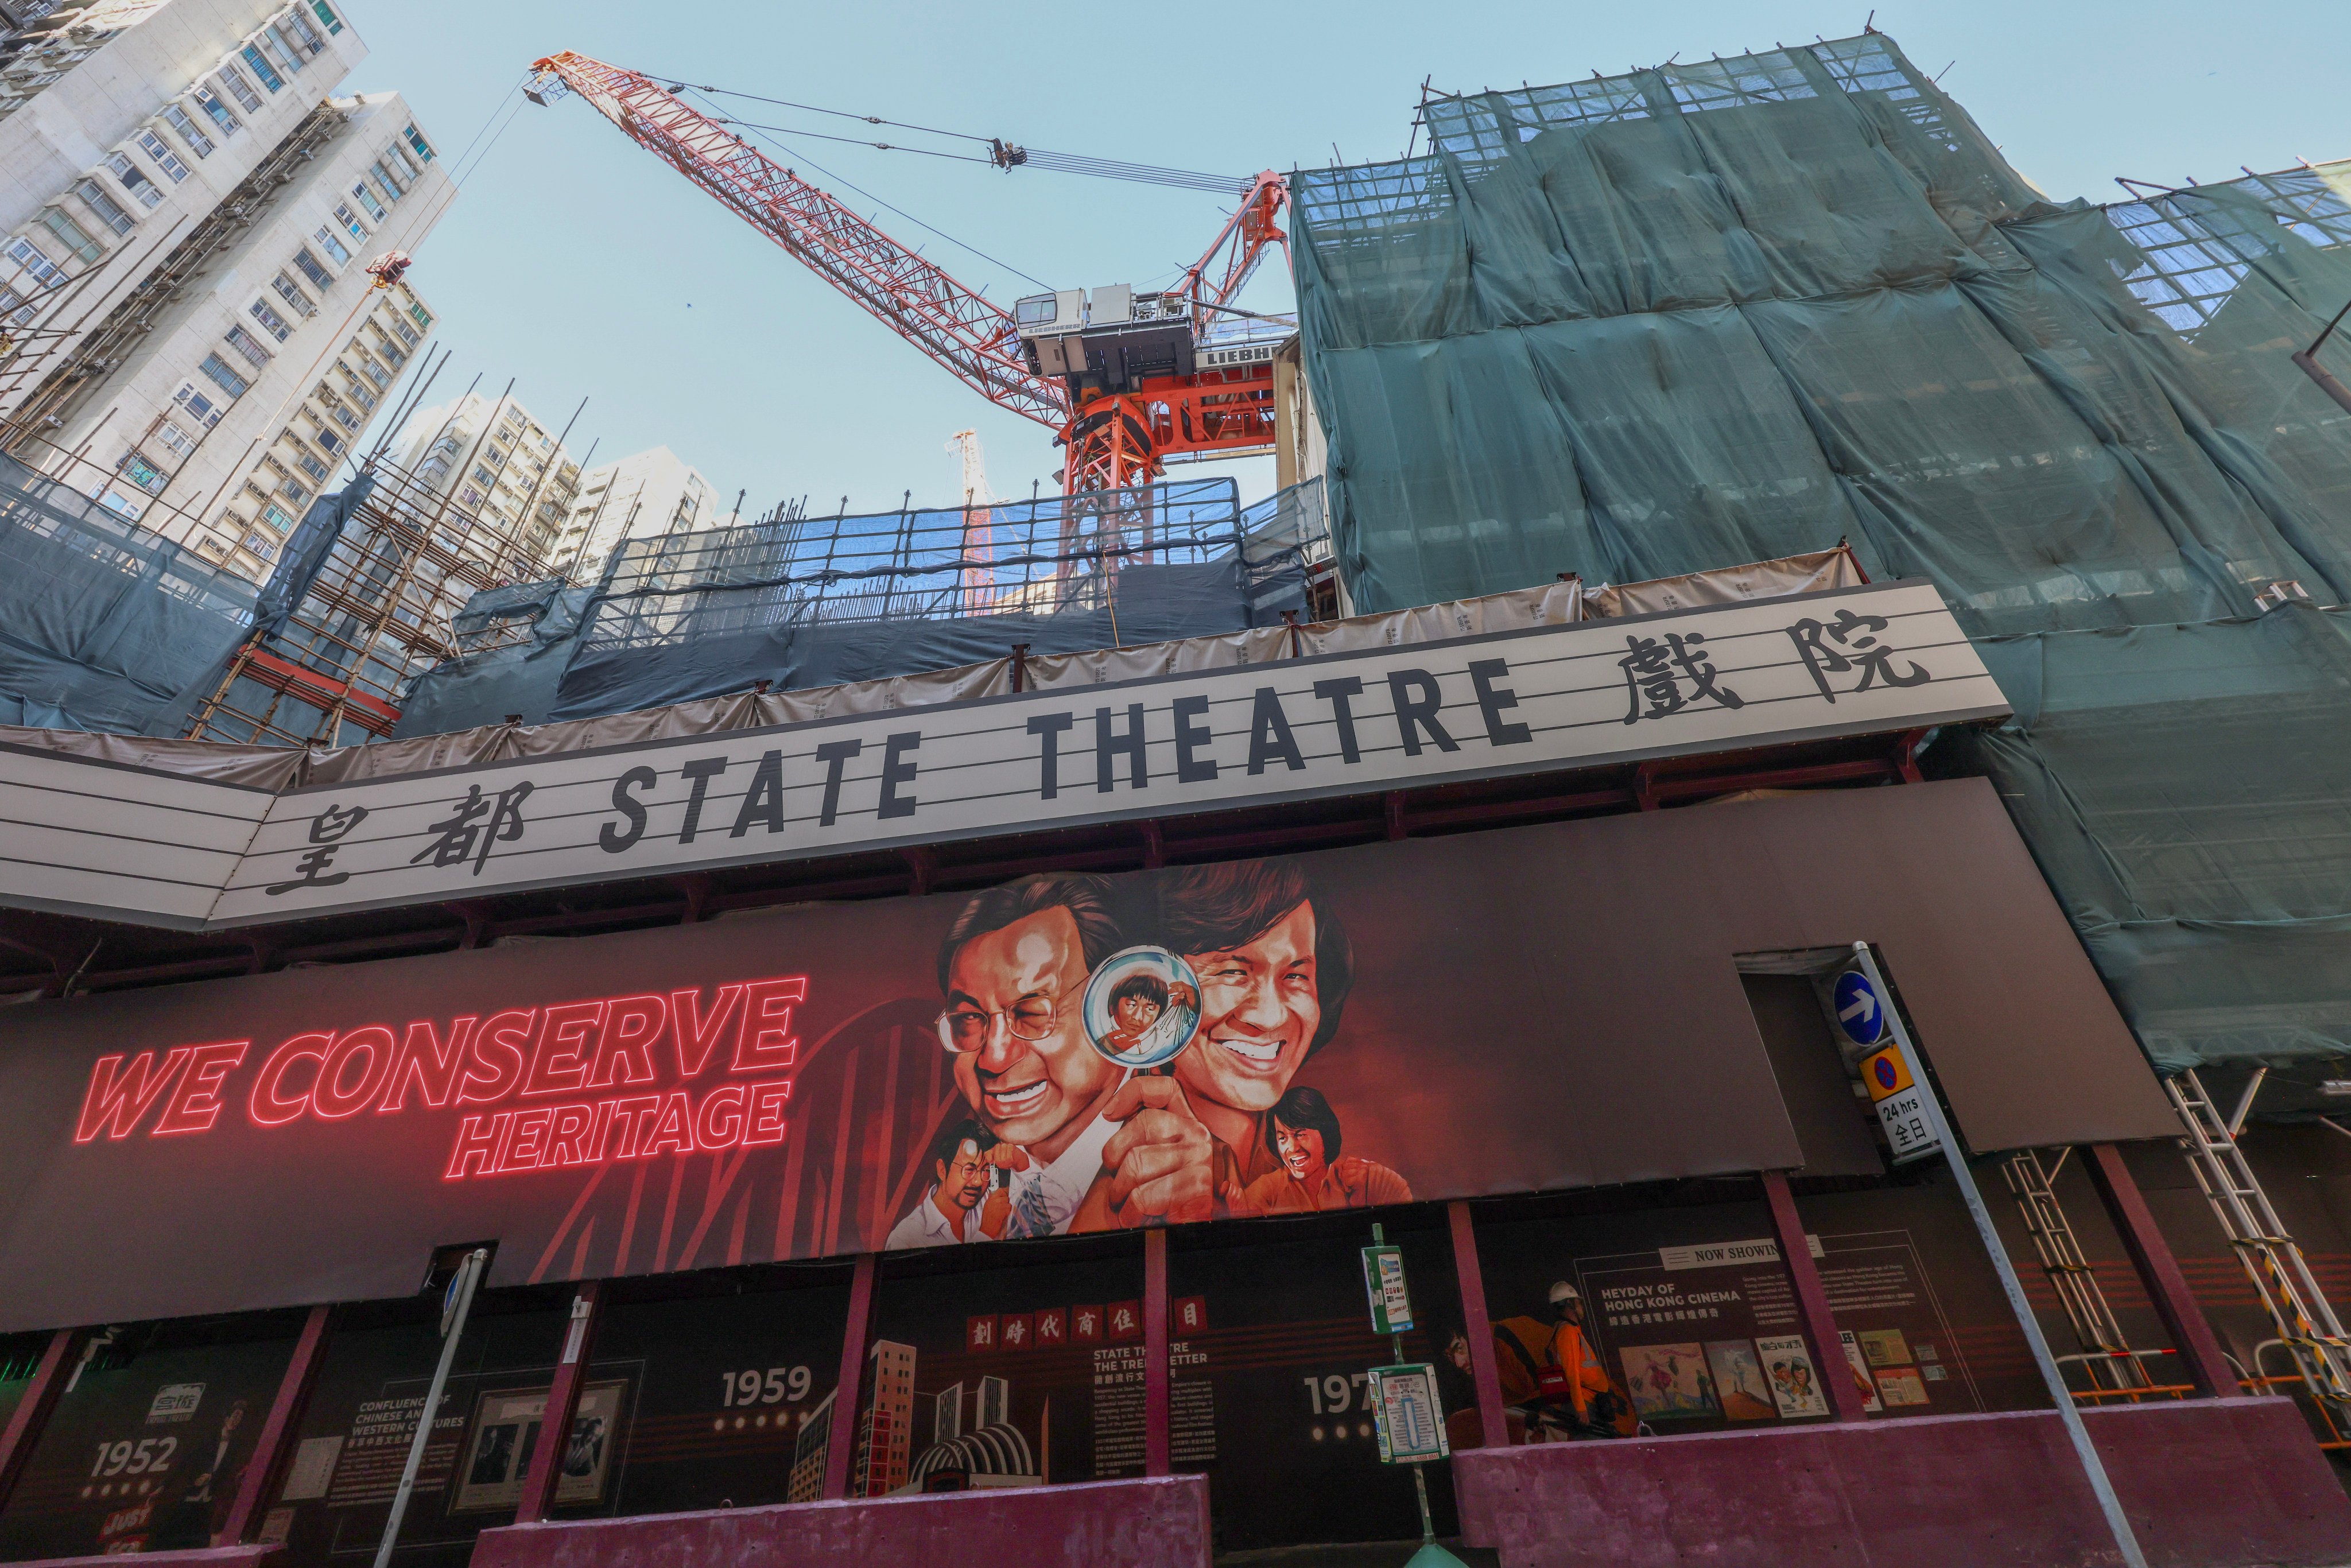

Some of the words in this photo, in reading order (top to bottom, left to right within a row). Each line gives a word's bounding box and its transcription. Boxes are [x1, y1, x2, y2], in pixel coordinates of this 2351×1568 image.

[1029, 323, 1081, 333] LIEBHERR
[1208, 347, 1277, 364] LIEBH
[266, 780, 535, 897] 皇都
[599, 731, 921, 853] STATE
[1026, 658, 1533, 800] THEATRE
[1617, 609, 1930, 725] 戲院
[76, 1042, 249, 1142] WE
[250, 977, 806, 1124] CONSERVE
[1883, 1103, 1899, 1121] 24
[1899, 1099, 1918, 1114] hrs
[445, 1081, 791, 1178] HERITAGE
[1895, 1117, 1927, 1147] 全日
[1694, 1248, 1724, 1262] NOW
[1729, 1244, 1779, 1259] SHOWIN
[1601, 1285, 1653, 1299] HEYDAY
[1658, 1283, 1675, 1295] OF
[1604, 1298, 1643, 1311] HONG
[1647, 1295, 1685, 1309] KONG
[1687, 1290, 1741, 1305] CINEMA
[973, 1302, 1197, 1345] 劃時代商住目
[1094, 1348, 1130, 1360] STATE
[1094, 1361, 1118, 1373] THE
[723, 1365, 812, 1407] 1959
[1303, 1373, 1372, 1414] 197
[359, 1397, 426, 1412] CONFLUENC
[356, 1410, 403, 1424] CHINESE
[405, 1409, 423, 1420] AN
[352, 1422, 405, 1437] WESTERN
[91, 1437, 177, 1477] 1952
